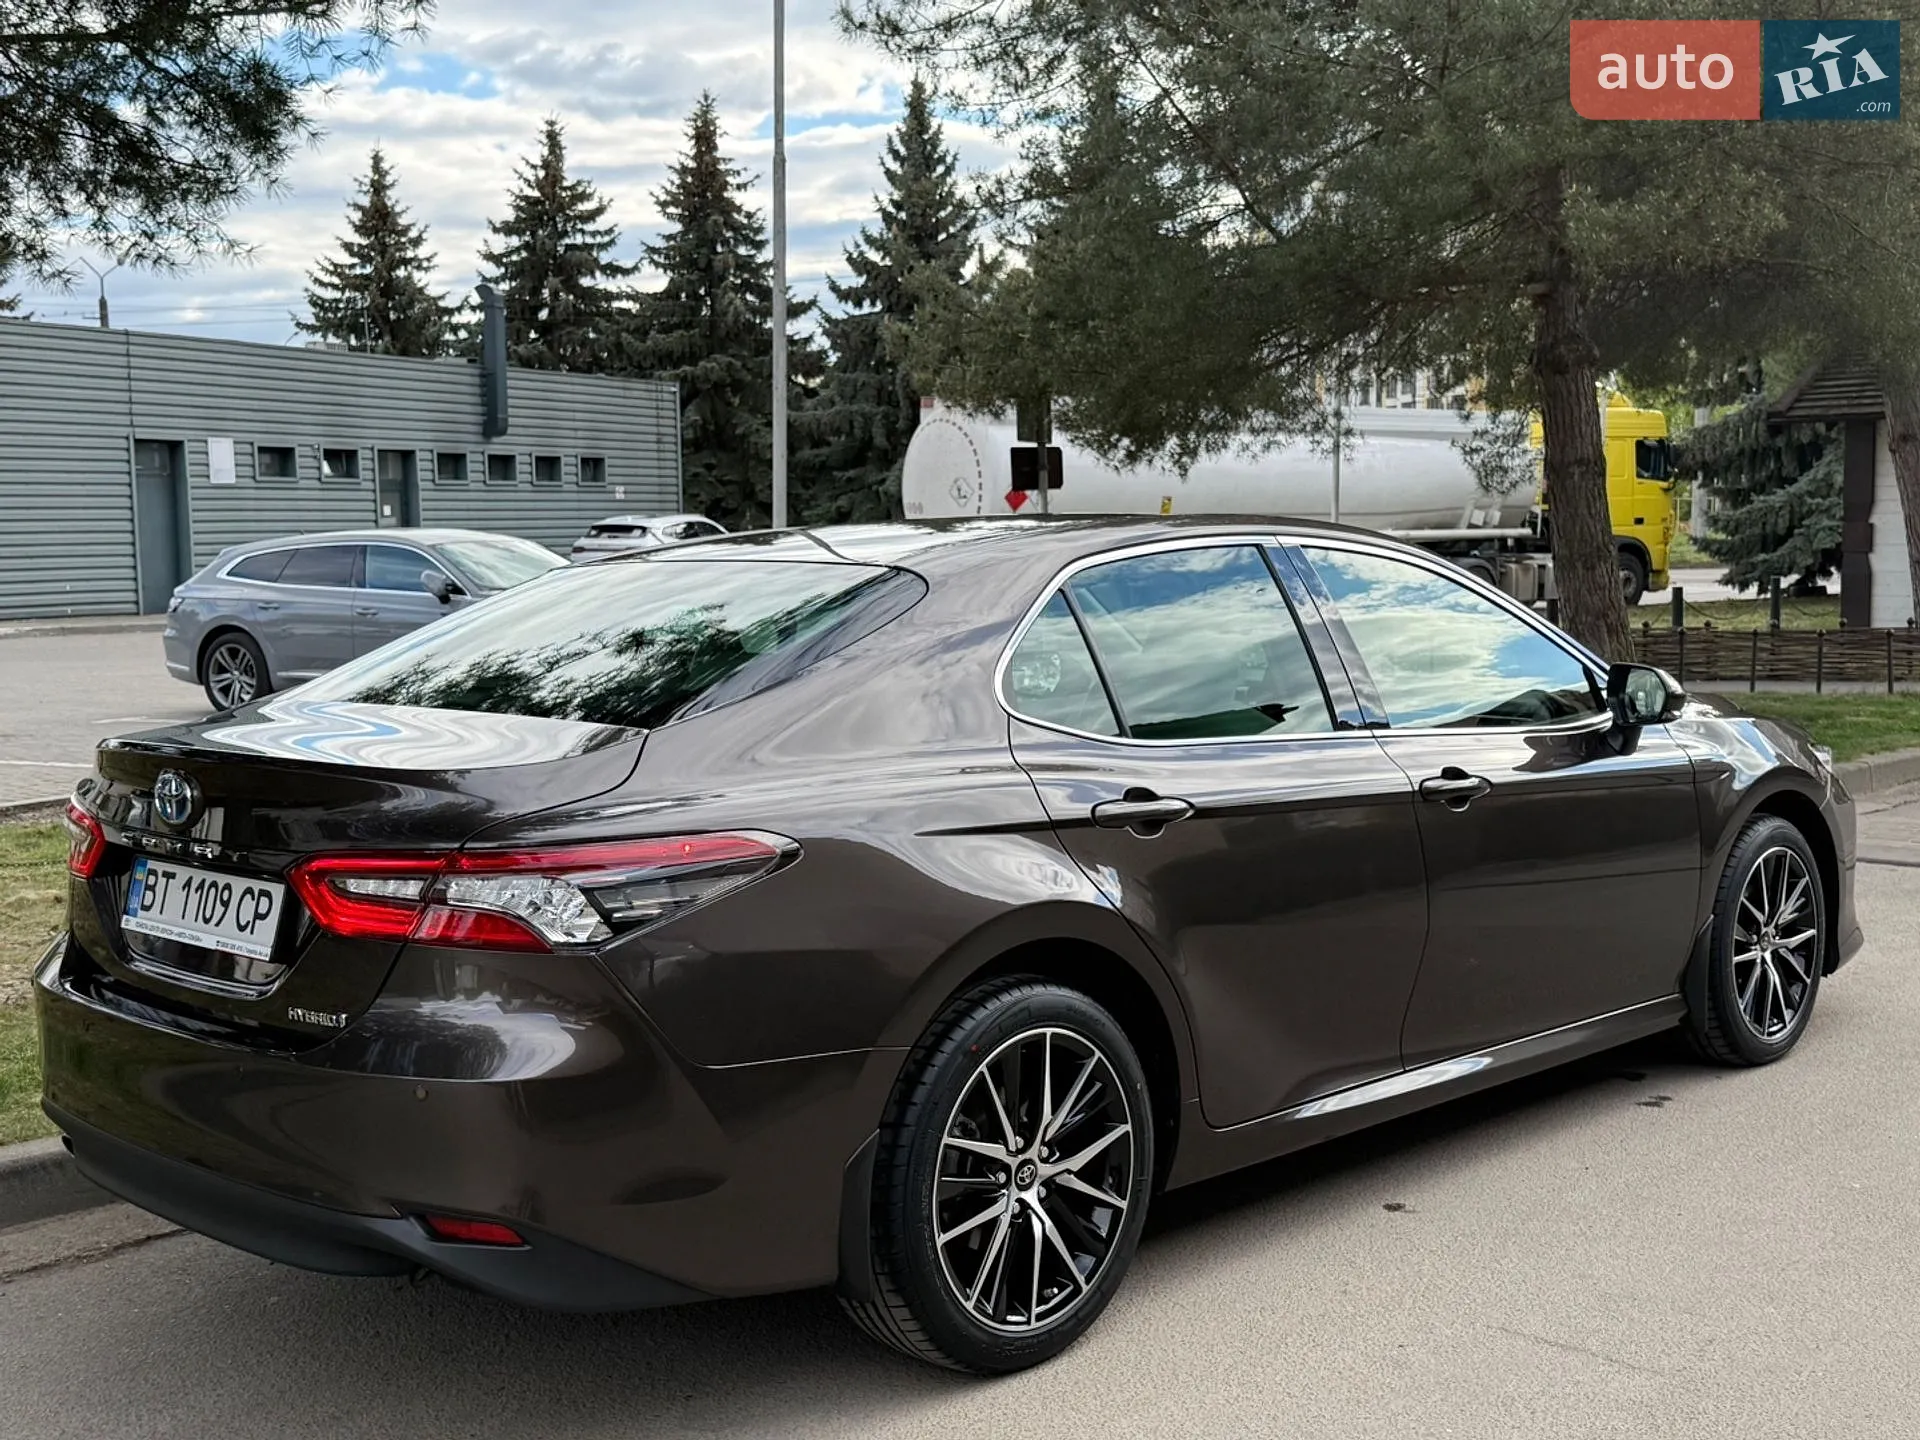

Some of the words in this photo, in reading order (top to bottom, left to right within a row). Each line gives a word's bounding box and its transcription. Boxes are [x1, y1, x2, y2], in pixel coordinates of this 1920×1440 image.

[140, 867, 176, 915] BT
[181, 875, 232, 927] 1109
[236, 886, 273, 935] CP
